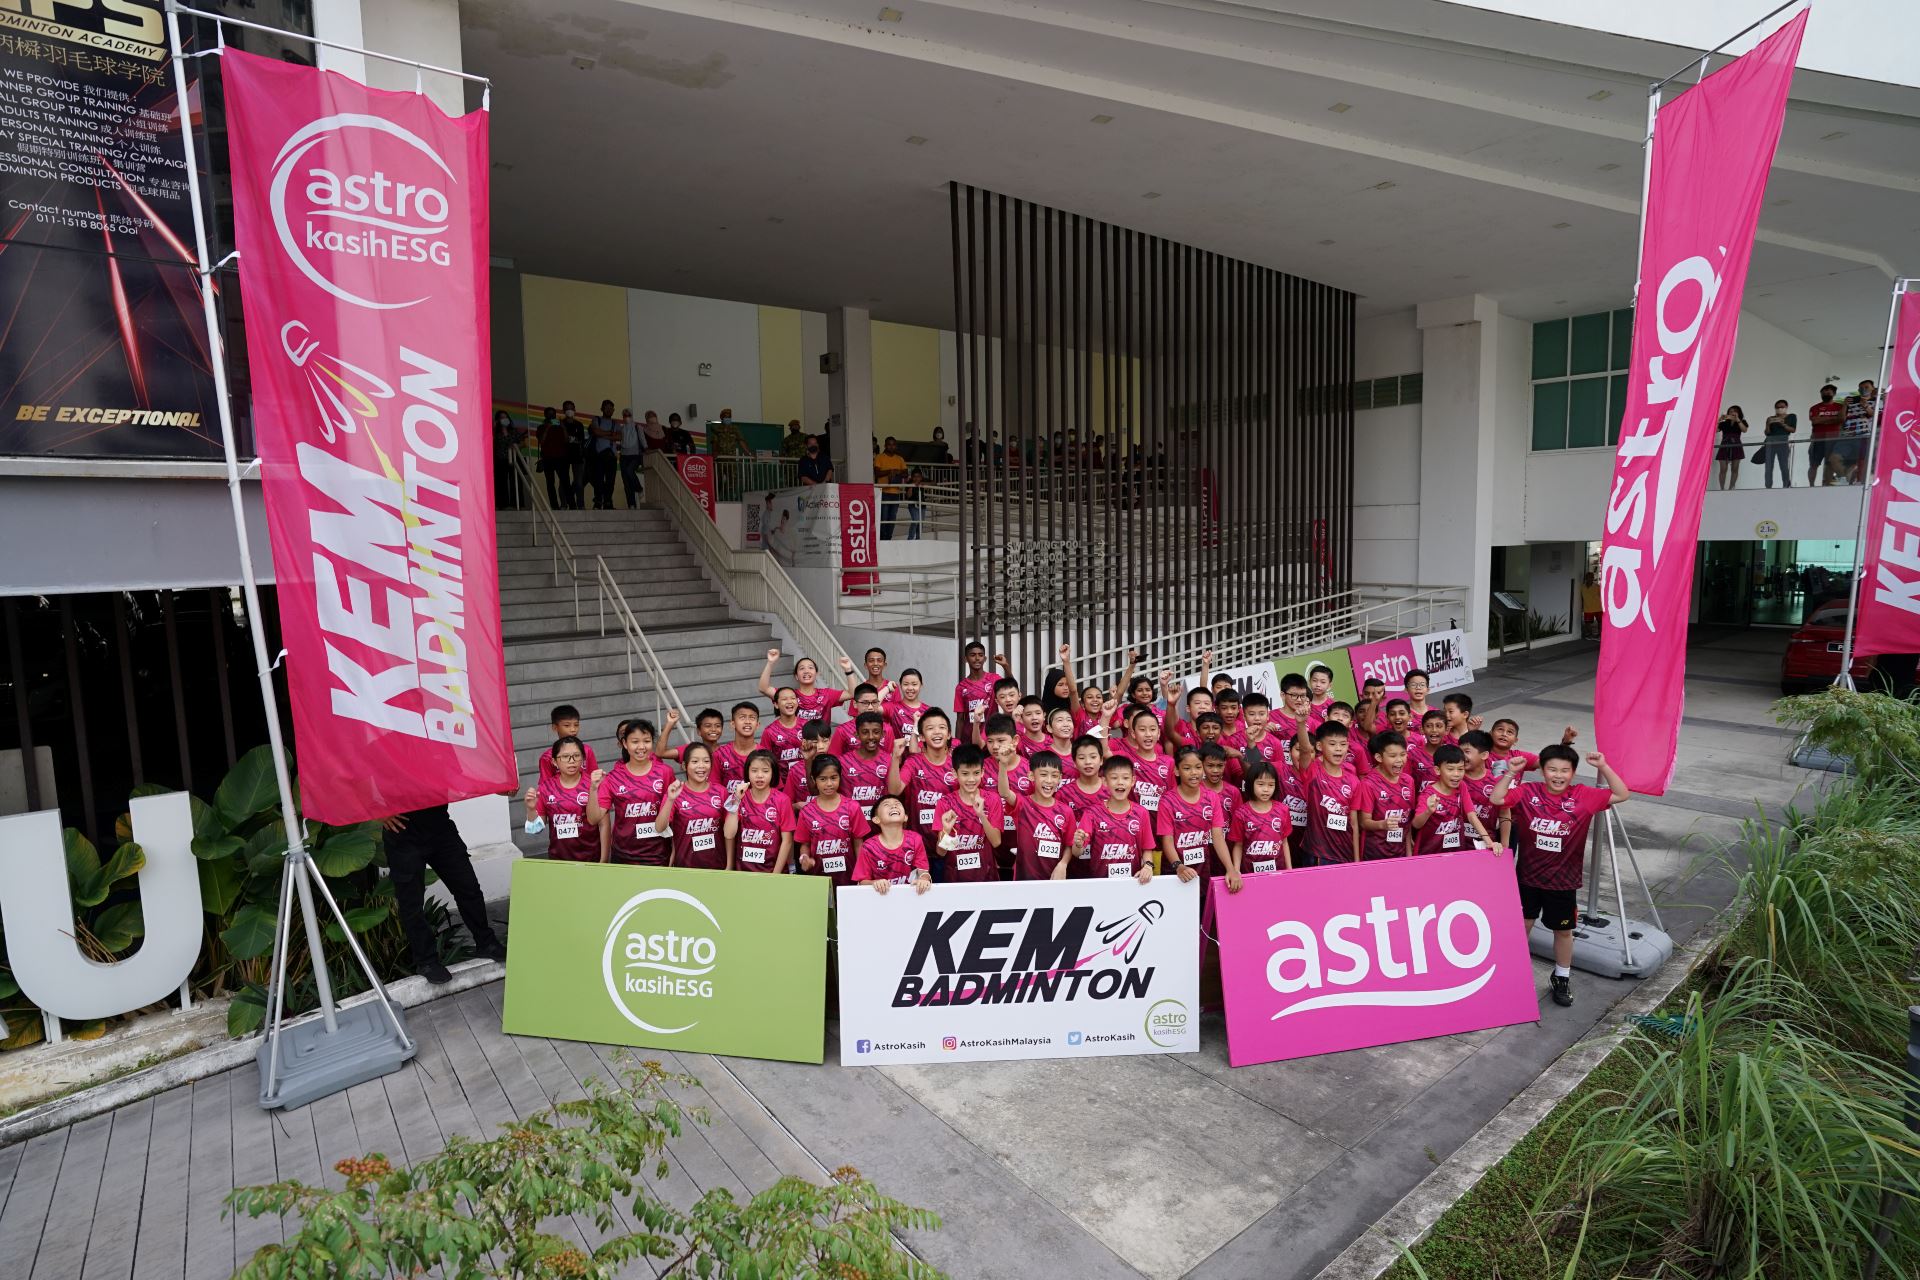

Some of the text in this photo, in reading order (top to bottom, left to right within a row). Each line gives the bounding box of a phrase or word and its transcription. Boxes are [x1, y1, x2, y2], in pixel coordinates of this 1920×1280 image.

[78, 33, 158, 57] ACADEMY
[4, 68, 23, 80] WE
[27, 73, 80, 92] PROVIDE
[37, 88, 80, 103] GROUP
[83, 97, 137, 114] TRAINING
[21, 97, 65, 111] GROUP
[69, 105, 122, 123] TRAINING
[125, 117, 169, 133] 小组训练
[43, 112, 98, 130] TRAINING
[101, 124, 157, 142] 成人训练班
[18, 132, 66, 149] SPECIAL
[60, 128, 114, 146] TRAINING
[117, 139, 161, 155] 个人训练
[59, 162, 144, 183] CONSULTATION
[61, 173, 121, 190] PRODUCTS
[306, 168, 449, 223] astro
[8, 199, 59, 214] Contact
[62, 208, 106, 221] number
[36, 213, 88, 228] 011-1518
[118, 224, 138, 235] Ooi
[306, 220, 451, 267] kasihESG
[16, 404, 200, 428] BE EXCEPTIONAL
[1600, 254, 1723, 629] astro
[848, 499, 866, 564] astro
[1760, 525, 1776, 533] 2.1m
[399, 346, 478, 749] BADMINTON
[1006, 540, 1084, 552] SWIMMING POOL
[1006, 552, 1068, 564] DIVING POOL
[295, 441, 430, 740] KEM
[1425, 639, 1452, 665] KEM
[1362, 653, 1411, 684] astro
[1426, 656, 1464, 675] BADMINTON
[853, 786, 876, 797] KEM
[625, 801, 652, 814] KEM
[1141, 799, 1158, 807] 0499
[686, 817, 714, 831] KEM
[1328, 818, 1346, 827] 0455
[1530, 816, 1562, 832] KEM
[558, 827, 576, 836] 0477
[742, 828, 765, 841] KEM
[1178, 831, 1204, 844] KEM
[694, 837, 713, 848] 0258
[816, 839, 842, 852] KEM
[1040, 845, 1059, 855] 0232
[1101, 843, 1129, 855] KEM
[1538, 838, 1560, 849] 0452
[744, 850, 763, 859] 0497
[958, 857, 978, 866] 0327
[1184, 851, 1203, 861] 0343
[1109, 867, 1130, 876] 0459
[1255, 864, 1275, 873] 0248
[625, 930, 716, 965] astro
[902, 906, 1095, 976] KEM
[1265, 895, 1492, 994] astro
[625, 973, 713, 998] kasihESG
[891, 966, 1156, 1008] BADMINTON
[1152, 1011, 1187, 1026] astro
[1085, 1032, 1136, 1044] AstroKasih
[1153, 1026, 1187, 1036] kasihESG
[874, 1040, 926, 1051] AstroKasih
[960, 1035, 1052, 1049] AstroKasihMalaysia
